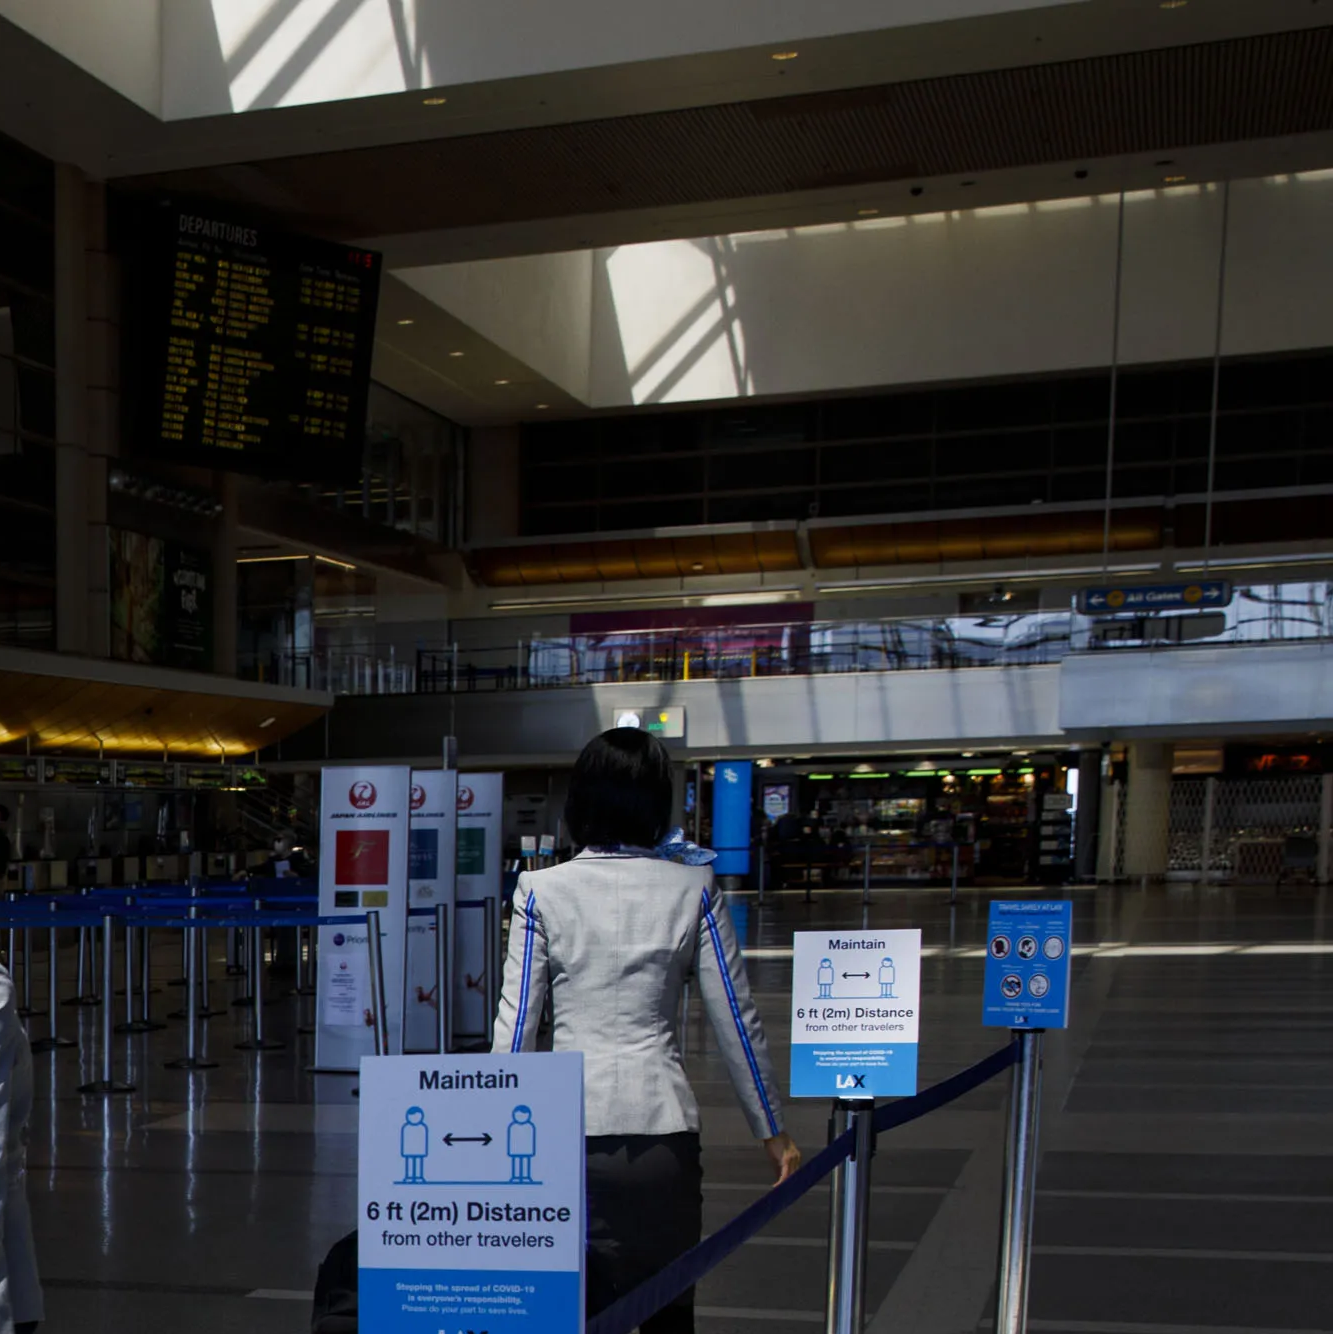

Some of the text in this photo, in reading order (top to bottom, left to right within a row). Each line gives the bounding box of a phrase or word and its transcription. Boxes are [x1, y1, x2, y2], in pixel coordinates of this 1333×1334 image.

[178, 213, 258, 248] DEPARTURES
[828, 939, 886, 951] Maintain
[797, 1008, 913, 1021] 6 ft (2m) Distance
[805, 1022, 904, 1032] from other travelers
[419, 1069, 518, 1090] Maintain
[836, 1074, 866, 1089] LAX
[367, 1201, 570, 1225] 6 ft (2m) Distance
[382, 1230, 554, 1248] from other travelers
[396, 1282, 535, 1294] Stopping the spread of COVID-19
[401, 1304, 426, 1313] Please
